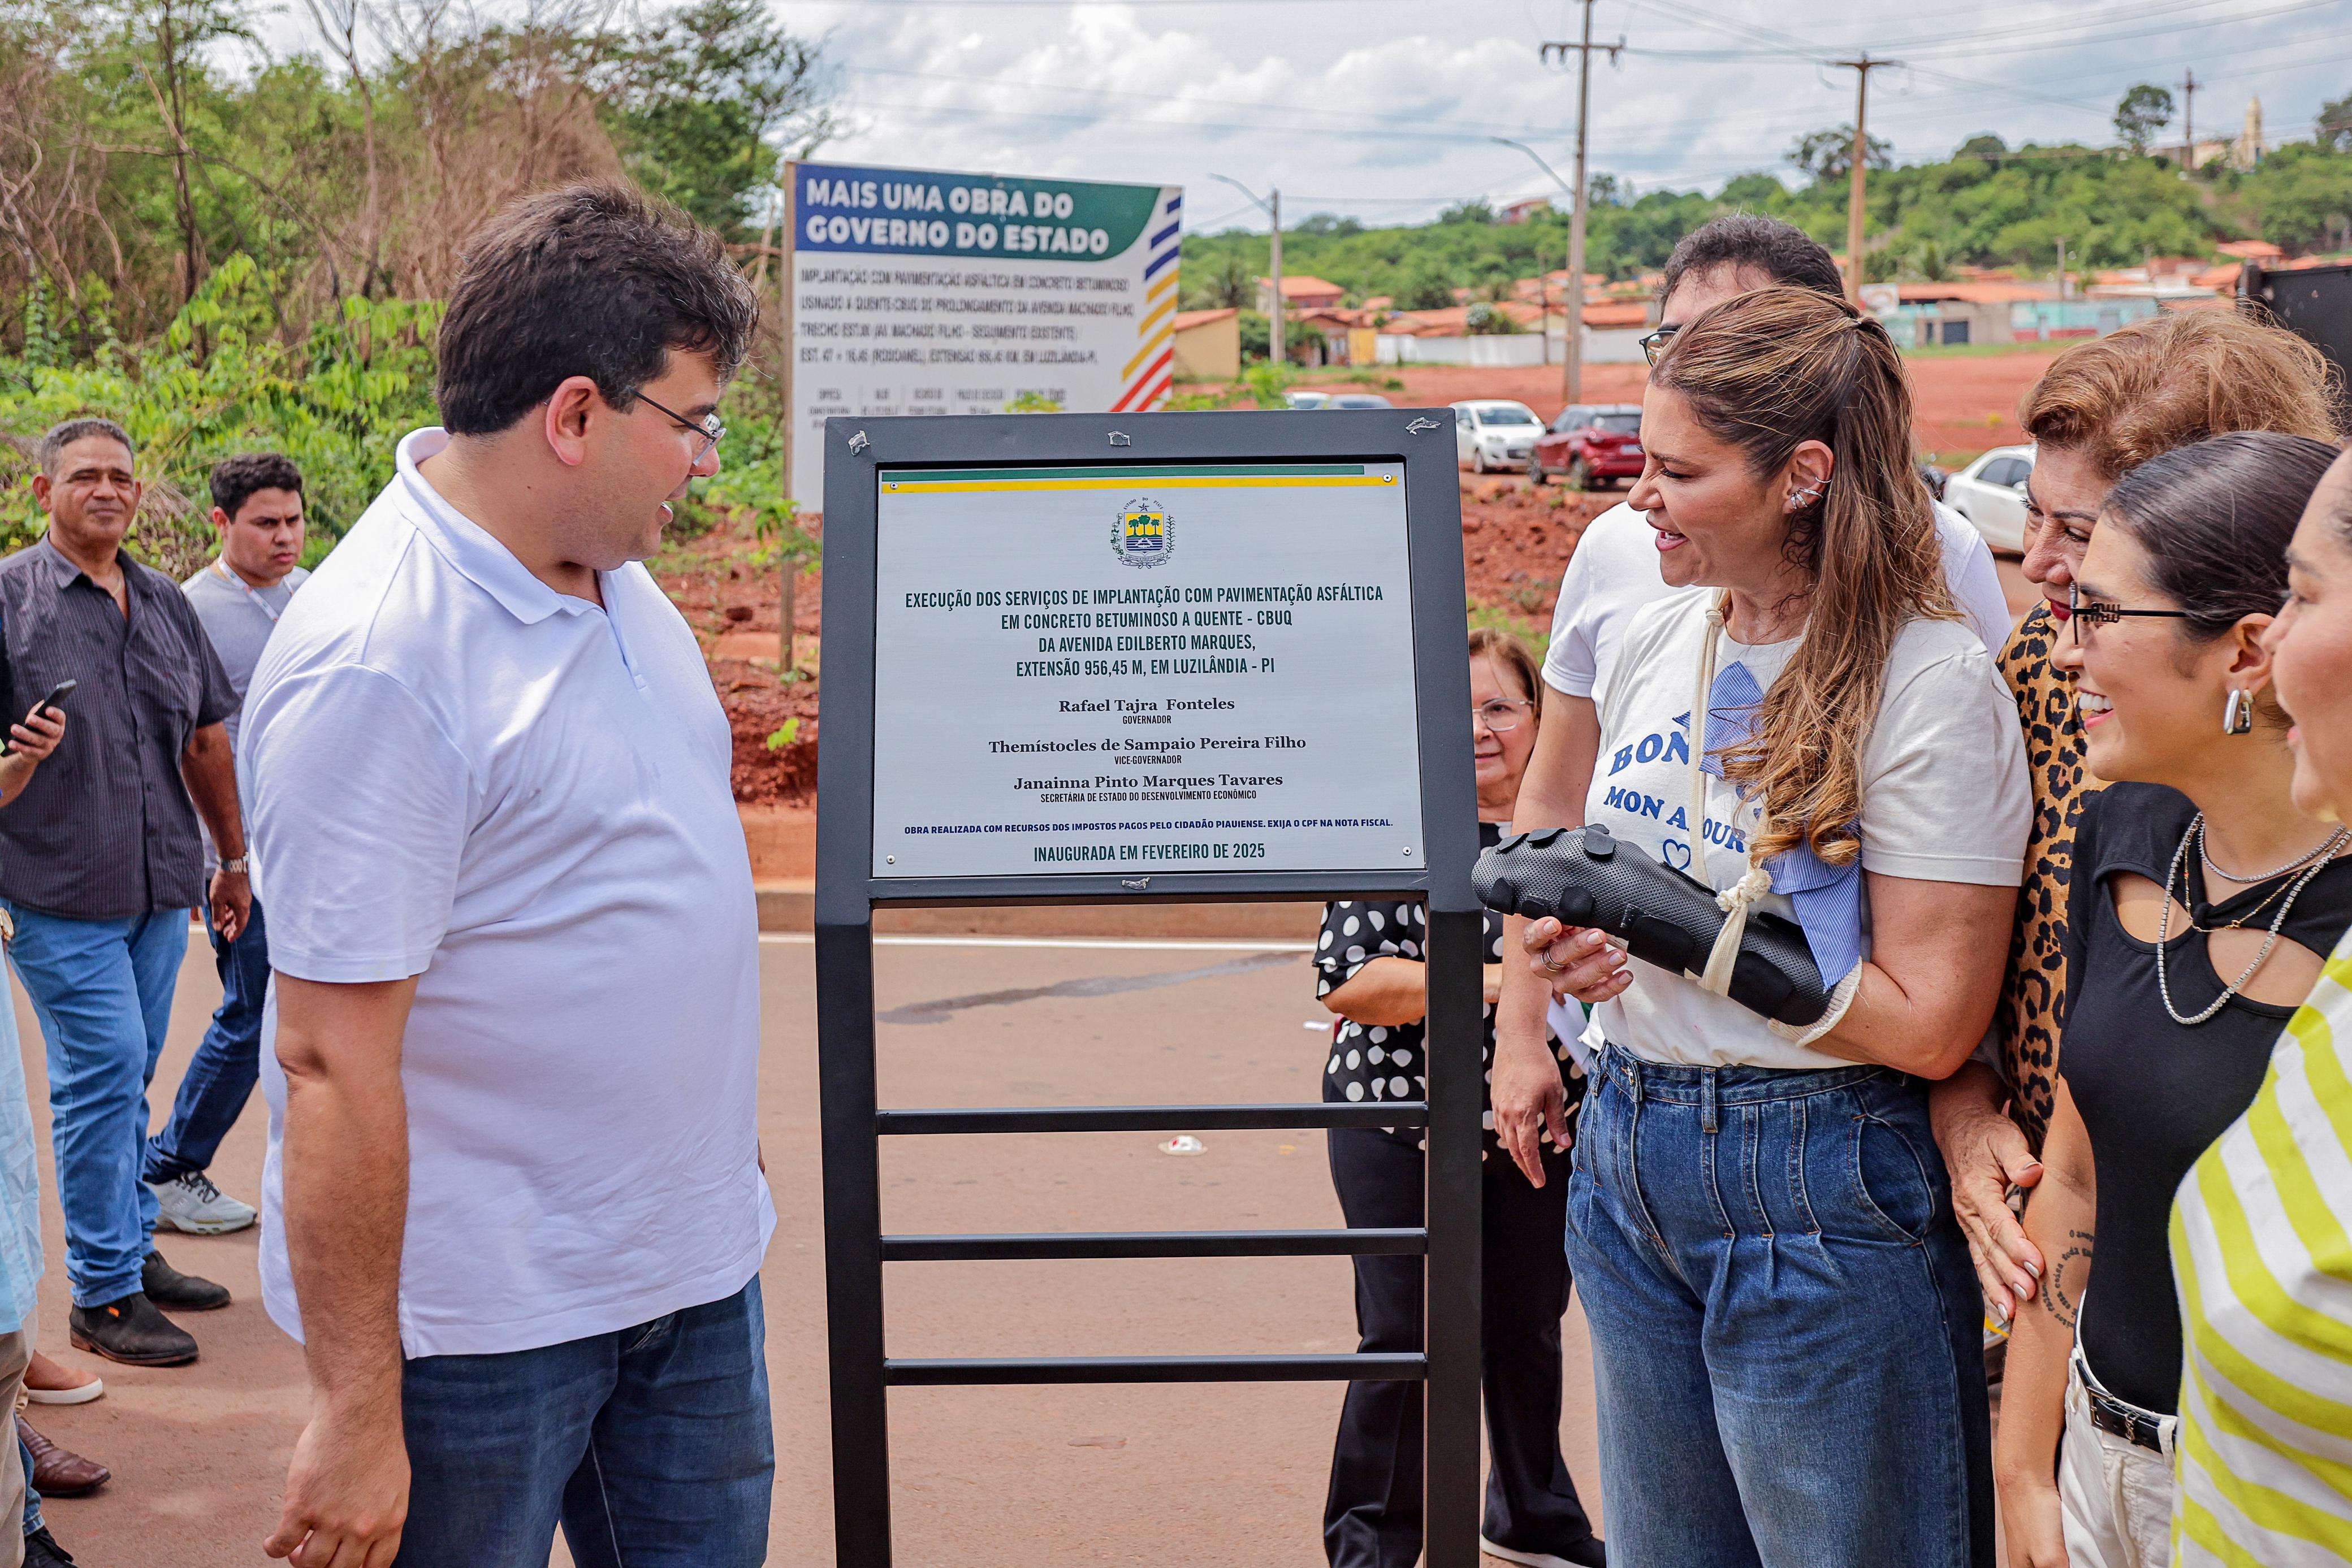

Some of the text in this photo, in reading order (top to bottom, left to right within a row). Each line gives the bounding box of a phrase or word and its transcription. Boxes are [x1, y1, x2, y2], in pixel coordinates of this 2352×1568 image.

[807, 179, 1073, 218] MAIS UMA OBRA DO
[806, 216, 1109, 254] GOVERNO DO ESTADO
[906, 582, 1383, 612] EXECUÇÃO DOS SERVIÇOS DE IMPLANTAÇÃO COM PAVIMENTAÇÃO ASFÁLTICA
[1001, 614, 1019, 630] EM
[1024, 613, 1091, 630] CONCRETO
[1096, 611, 1178, 629] BETUMINOSO
[1182, 610, 1190, 627] A
[1194, 610, 1243, 627] QUENTE
[1257, 609, 1292, 626] CBUQ
[1039, 634, 1256, 653] DA AVENIDA EDILBERTO MARQUES,
[1017, 657, 1080, 677] EXTENSÃO
[1084, 659, 1127, 678] 956,45
[1132, 660, 1147, 678] M,
[1151, 659, 1169, 675] EM
[1173, 655, 1248, 674] LUZILÂNDIA
[1261, 657, 1274, 673] PI
[1058, 697, 1235, 714] Rafael Tajra Fonteles
[1122, 714, 1171, 725] GOVERNADOR
[988, 735, 1306, 753] Themístocles de Sampaio Pereira Filho
[1114, 754, 1182, 765] VICE-GOVERNADOR
[1014, 774, 1283, 792] Janainna Pinto Marques Tavares
[1040, 788, 1257, 803] SECRETÁRIA DE ESTADO DO DESENVOLVIMENTO ECONÔMICO
[904, 826, 929, 835] OBRA
[931, 825, 982, 834] REALIZADA
[984, 824, 1002, 833] COM
[1005, 823, 1050, 833] RECURSOS
[1052, 822, 1070, 831] DOS
[1072, 822, 1117, 831] IMPOSTOS
[1118, 821, 1148, 830] PAGOS
[1149, 821, 1172, 830] PELO
[1174, 818, 1214, 829] CIDADÃO
[1216, 820, 1266, 829] PIAUIENSE.
[1267, 819, 1292, 830] EXIJA
[1302, 819, 1318, 828] CPF
[1320, 819, 1333, 828] NA
[1335, 818, 1359, 828] NOTA
[1361, 818, 1393, 827] FISCAL.
[1603, 786, 1746, 853] MON AOUR
[1034, 842, 1265, 862] INAUGURADA EM FEVEREIRO DE 2025
